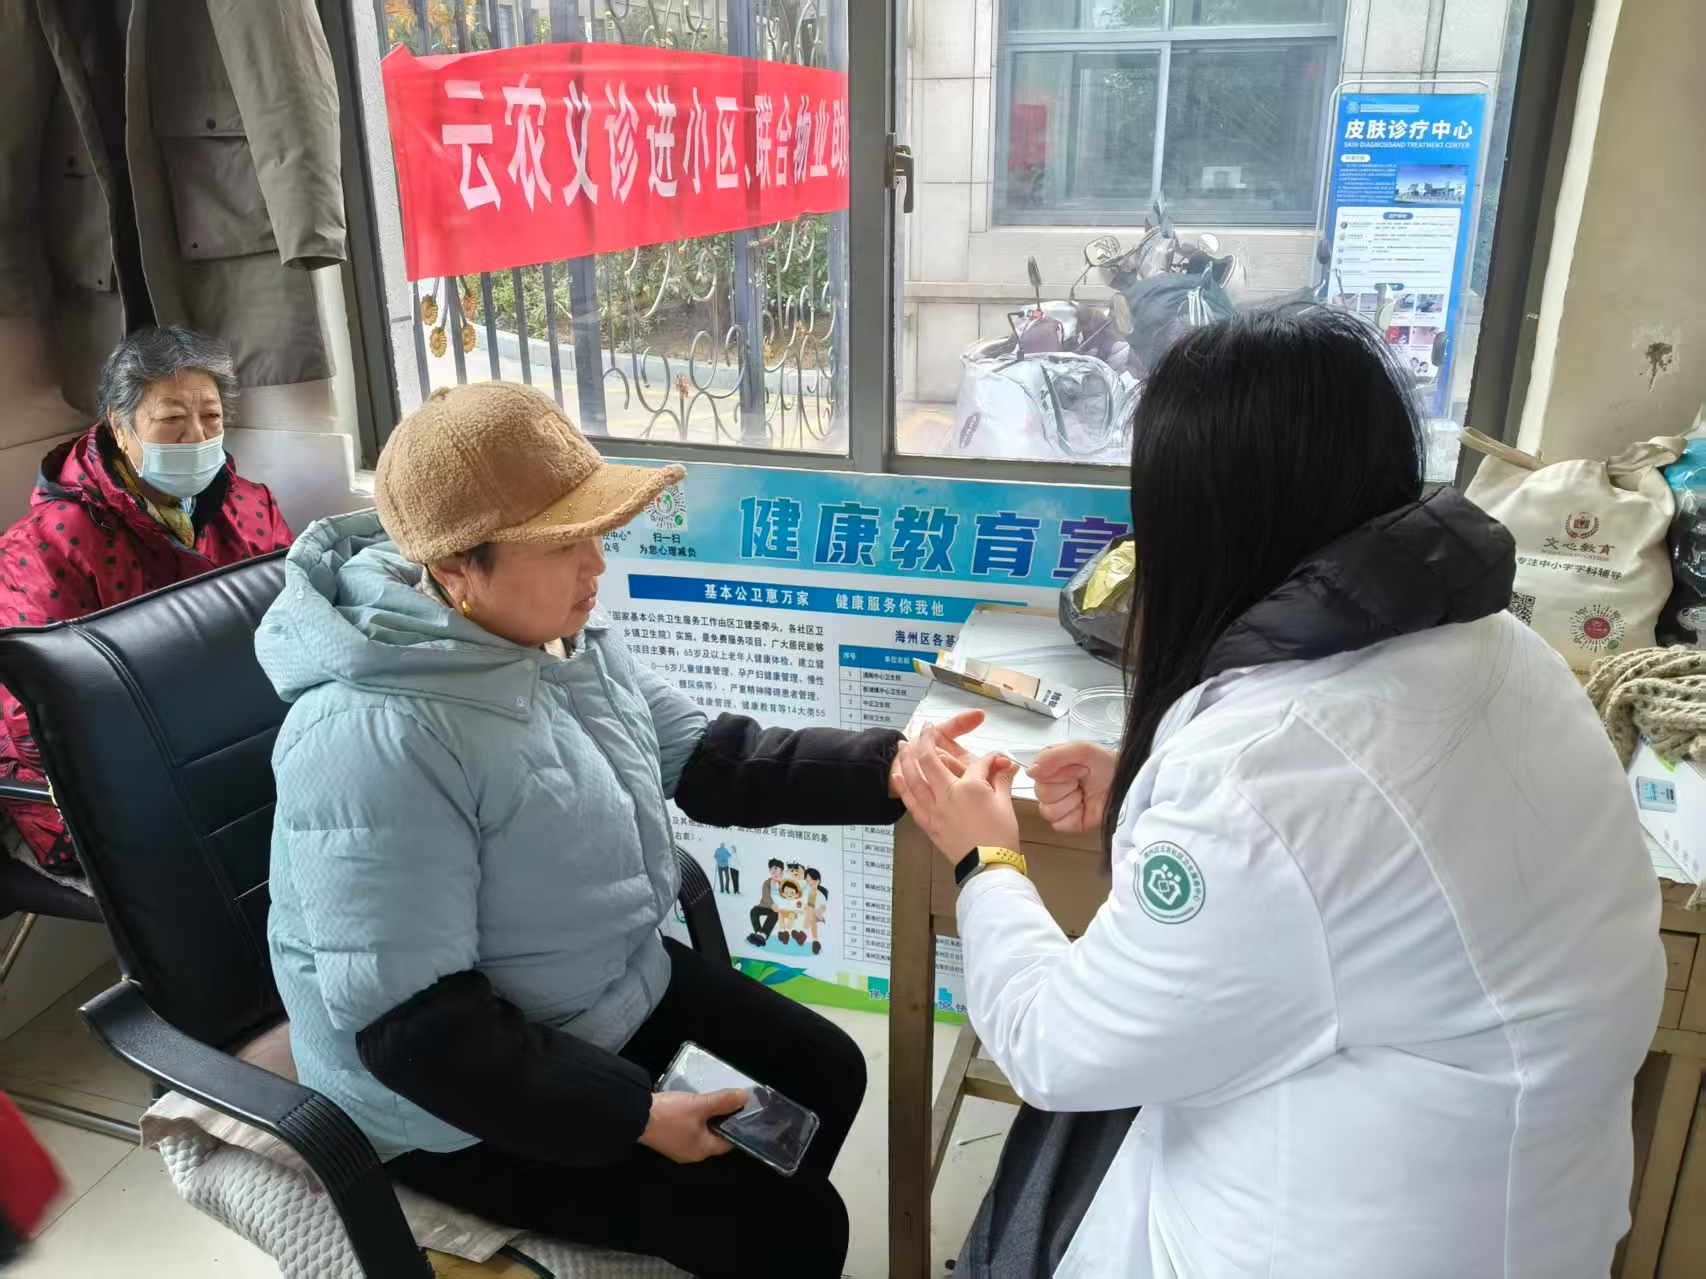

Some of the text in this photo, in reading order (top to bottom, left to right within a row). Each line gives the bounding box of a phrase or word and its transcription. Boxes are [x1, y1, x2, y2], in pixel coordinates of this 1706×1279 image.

[1344, 118, 1473, 140] 皮肤诊疗中心
[653, 532, 681, 544] 扫一扫
[739, 496, 1129, 579] 健康教育宣
[640, 544, 697, 558] 为您心理减负
[704, 583, 944, 617] 基本公卫惠万家 健康服务你我他
